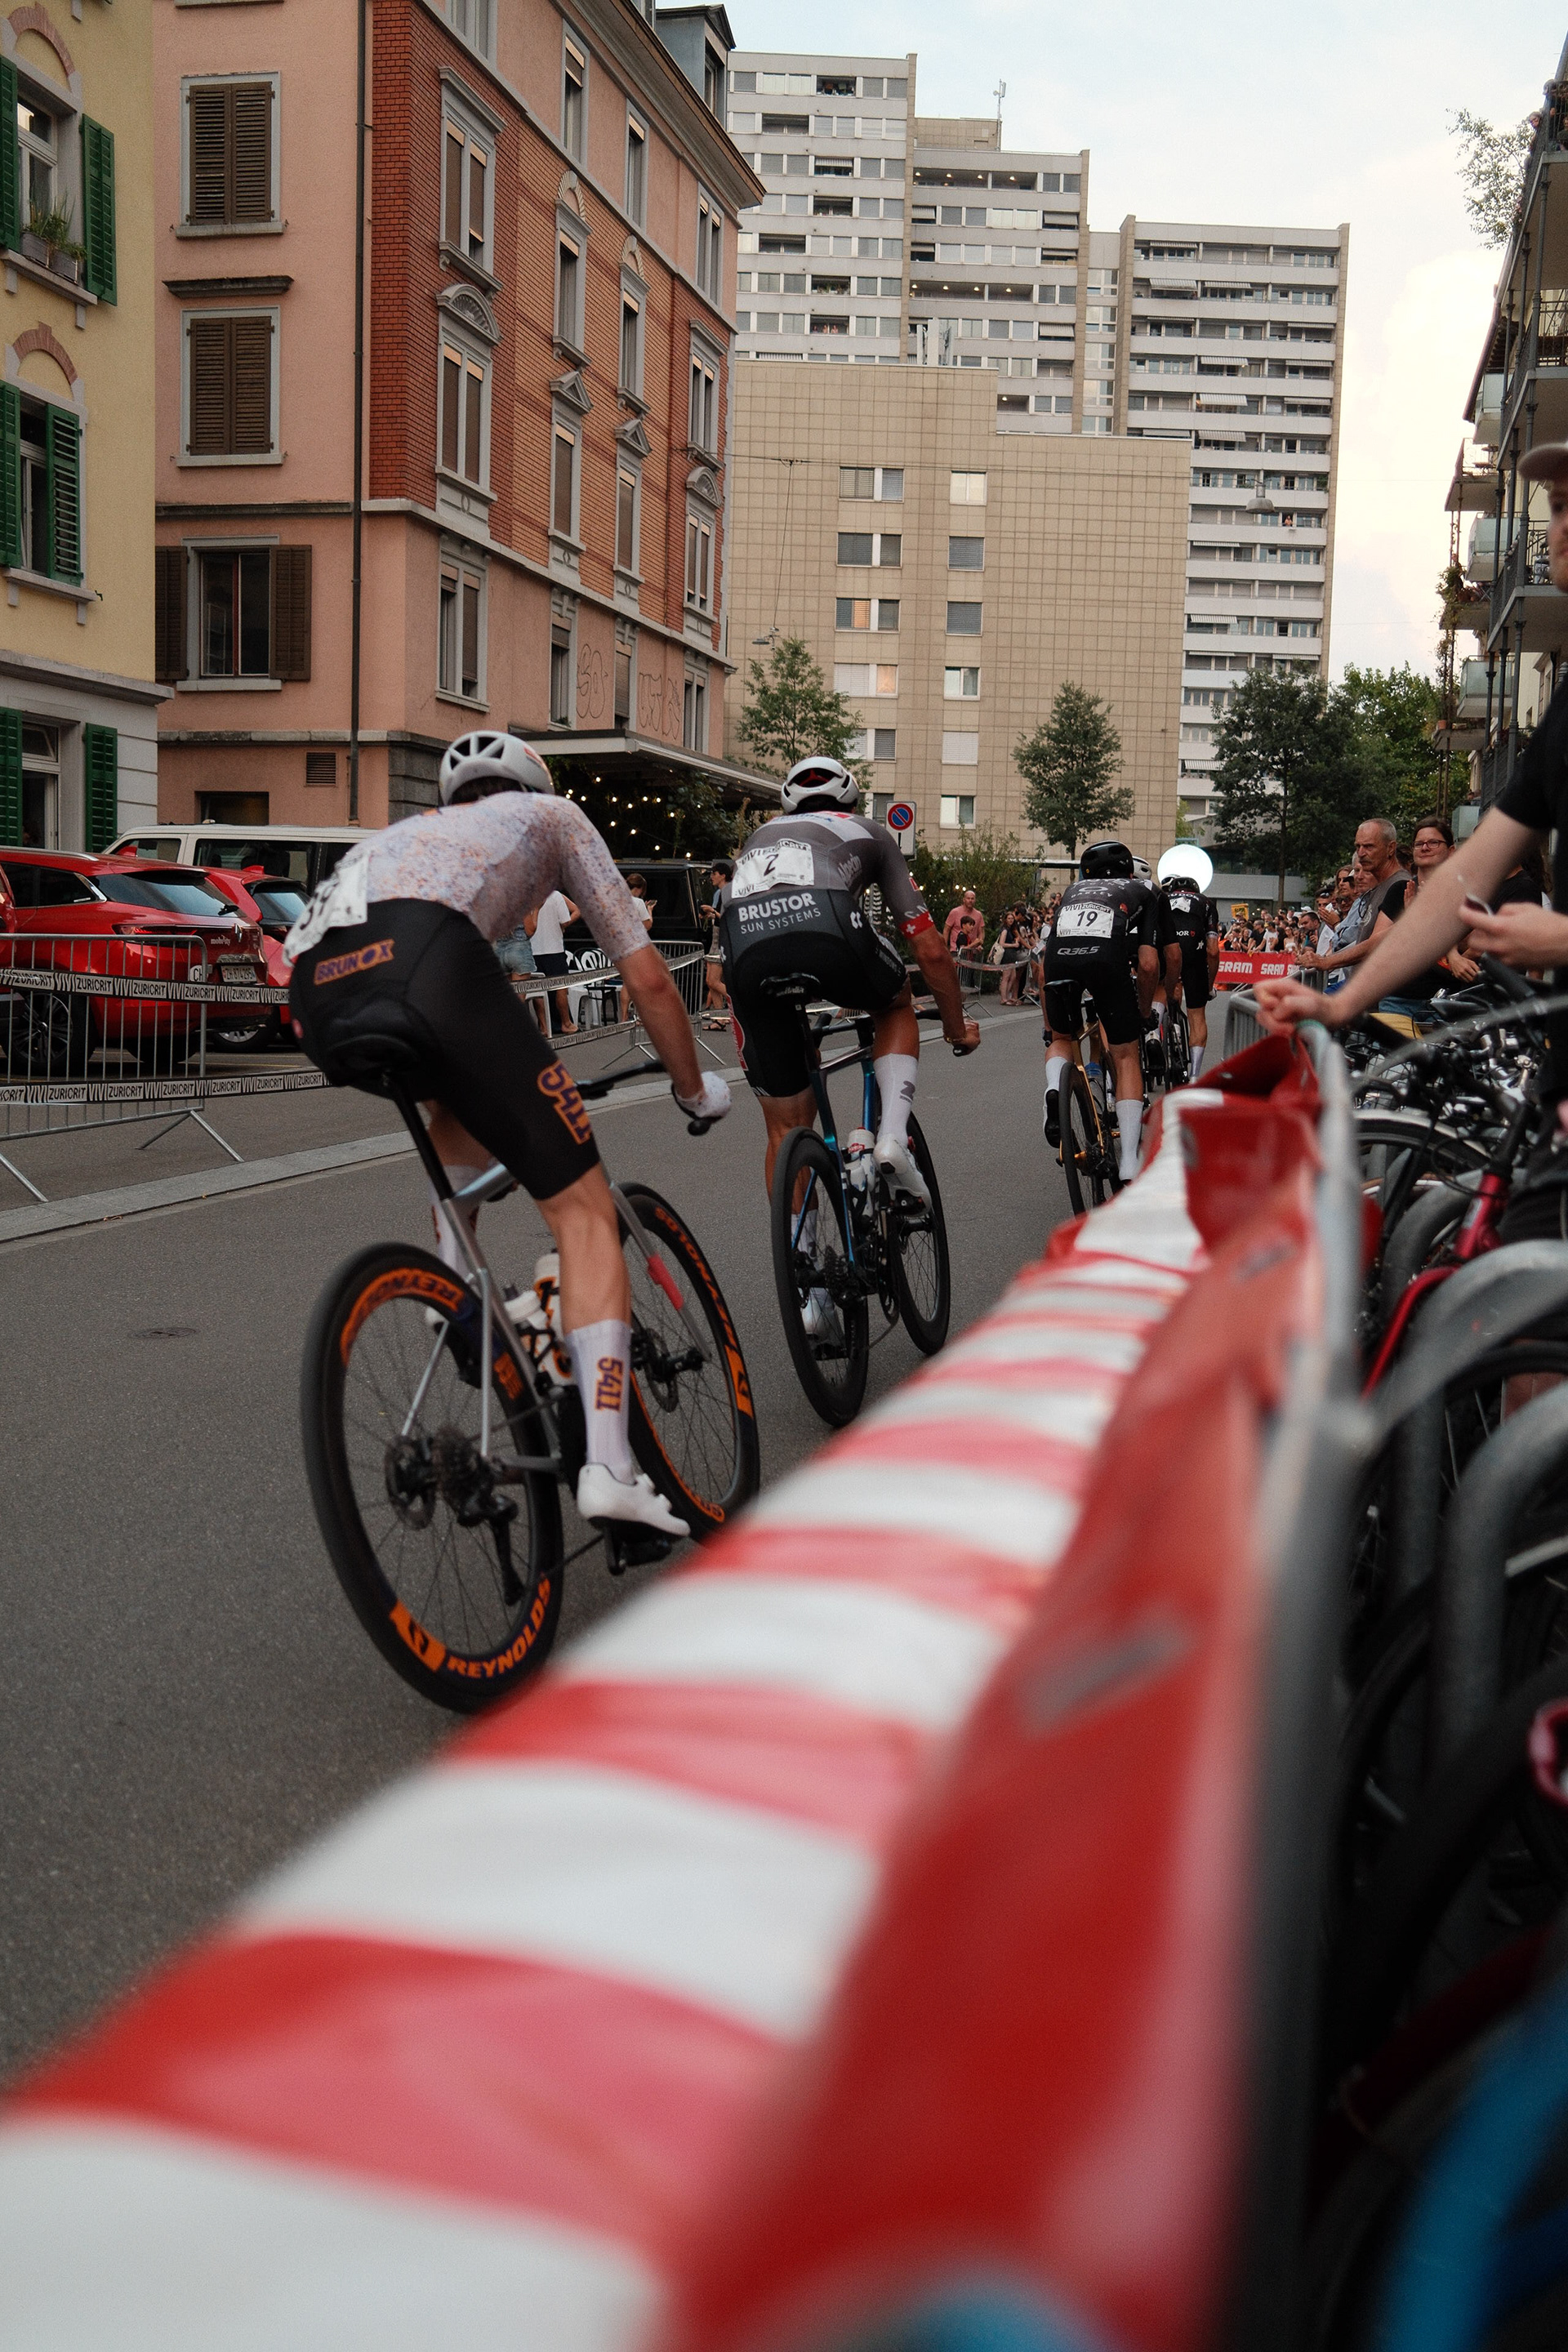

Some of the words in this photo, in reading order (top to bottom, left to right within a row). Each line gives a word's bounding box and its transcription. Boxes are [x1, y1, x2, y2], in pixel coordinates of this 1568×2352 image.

[764, 853, 779, 876] 2
[738, 893, 816, 922] BRUSTOR
[1077, 911, 1098, 927] 19
[741, 921, 764, 934] SUN
[768, 907, 822, 930] SYSTEMS
[1057, 946, 1100, 956] Q36.5
[1218, 961, 1253, 974] SRAM
[1260, 964, 1285, 975] SRAM
[77, 977, 112, 992] ZURICRIT
[133, 982, 165, 996] ZURICRIT
[185, 986, 215, 999] ZURICRIT
[232, 989, 259, 1001] ZURICRIT
[49, 1087, 86, 1100] ZURICRIT
[108, 1085, 143, 1098] ZURICRIT
[163, 1083, 194, 1095] ZURICRIT
[212, 1080, 240, 1093] ZURICRIT
[257, 1078, 283, 1089] ZURICRIT
[298, 1074, 323, 1086] ZURICRIT
[597, 1357, 624, 1411] 5411
[447, 1577, 551, 1679] REYNOLDS
